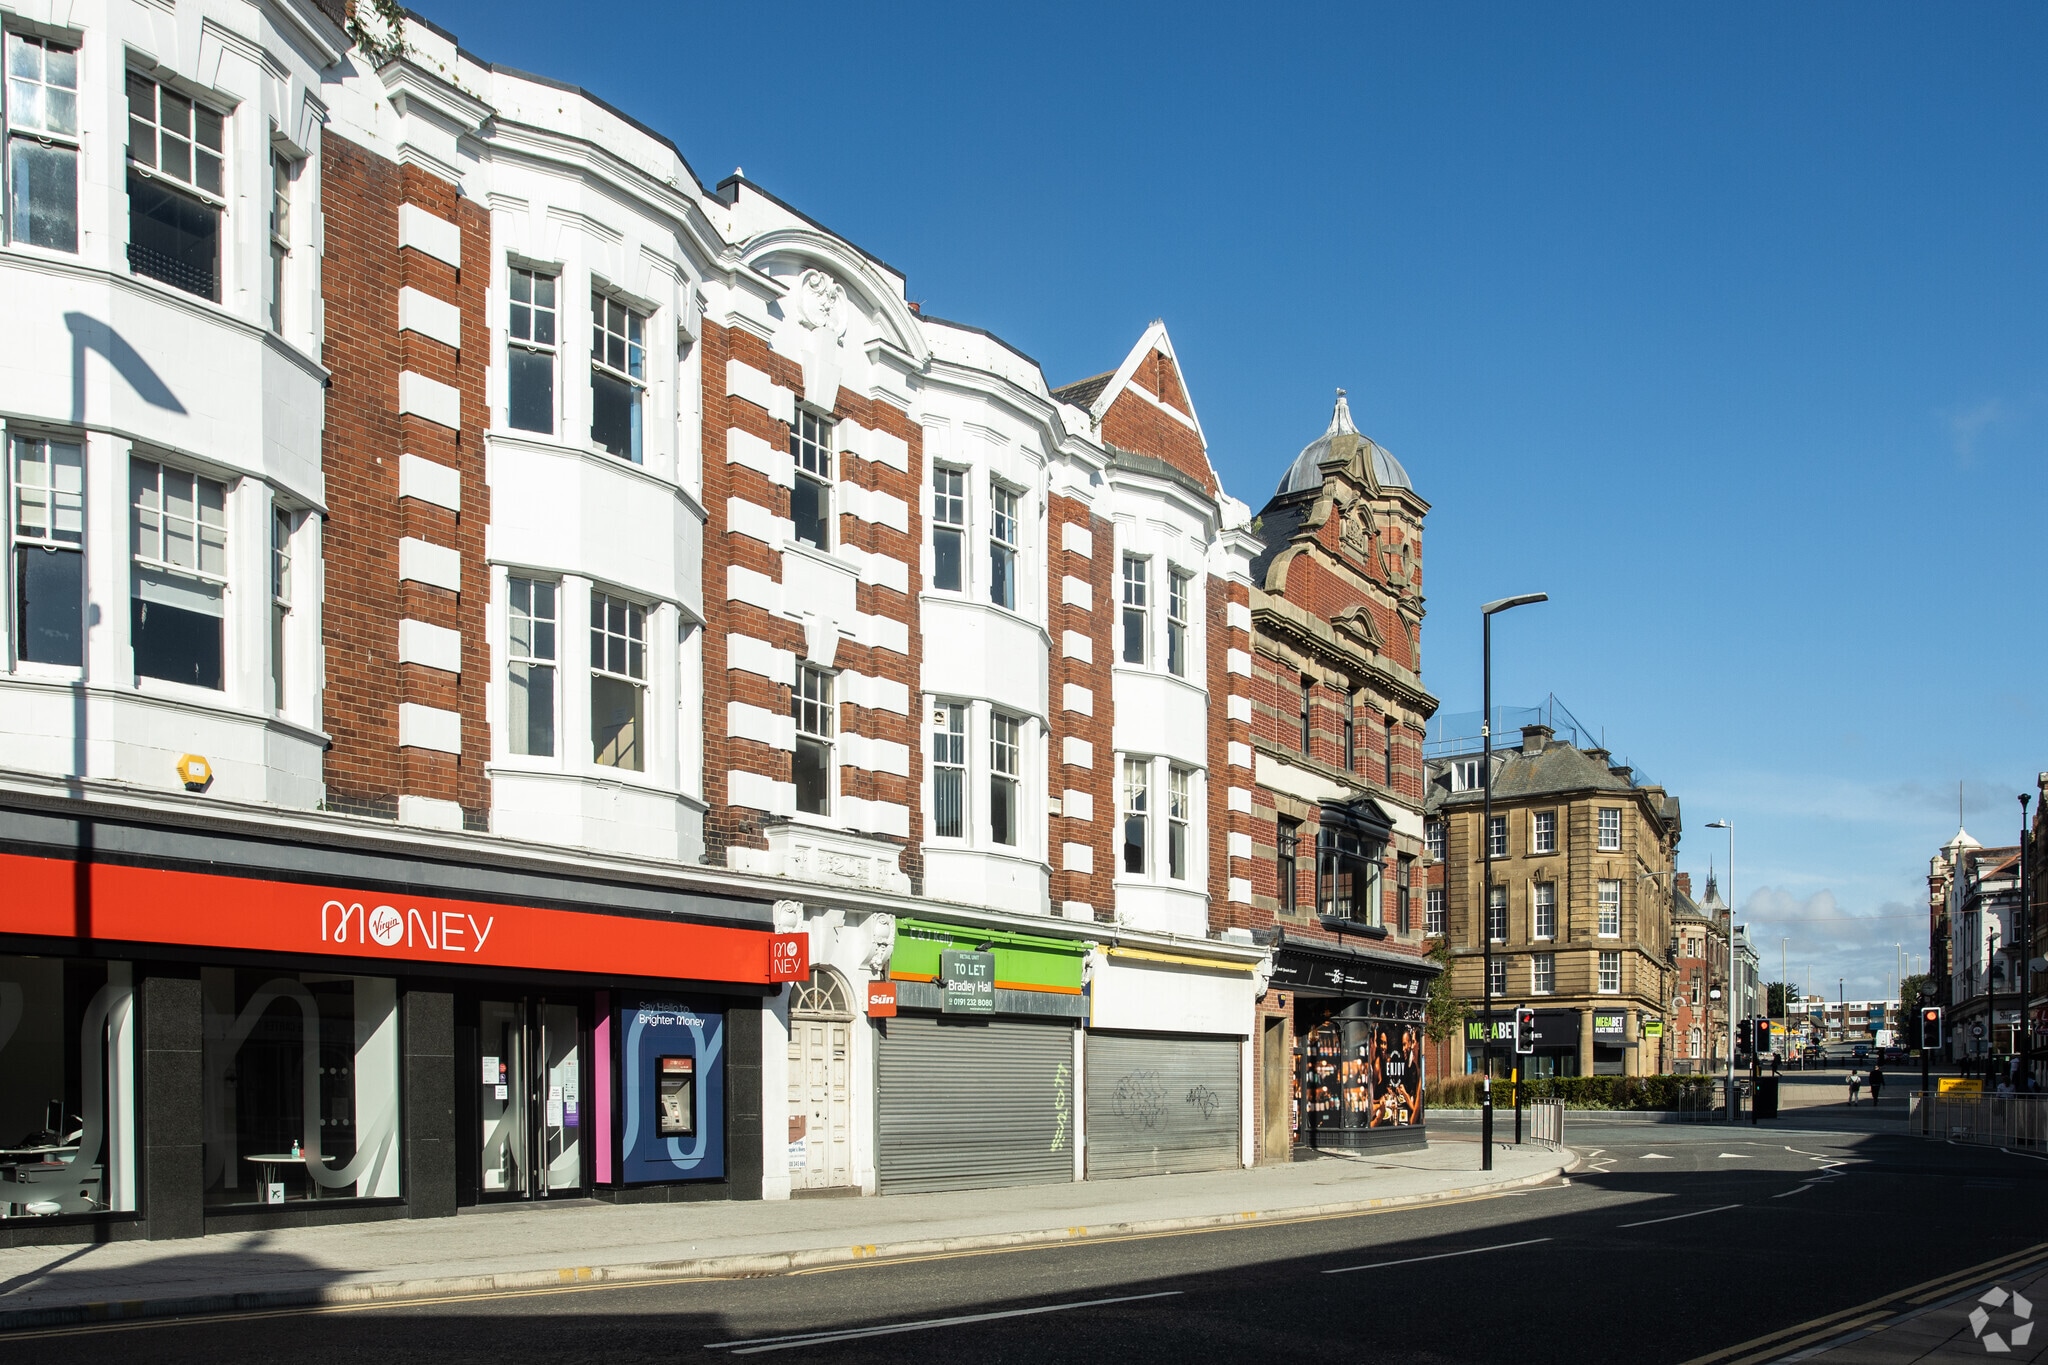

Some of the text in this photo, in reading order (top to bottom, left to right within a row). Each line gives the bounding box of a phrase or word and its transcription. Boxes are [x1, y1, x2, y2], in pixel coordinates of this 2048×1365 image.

[322, 900, 494, 952] MONEY
[373, 911, 400, 939] Virgin
[934, 930, 954, 947] Kelly
[774, 958, 801, 973] NEY
[954, 963, 986, 976] TO LET
[948, 980, 992, 996] Bradley Hall
[639, 1001, 655, 1014] Say
[680, 1004, 690, 1013] to
[953, 998, 993, 1007] 0191 232 8080
[639, 1014, 705, 1028] Brighter Money
[1596, 1017, 1623, 1027] MEGABET
[1469, 1022, 1517, 1040] MEABET
[1386, 1062, 1405, 1076] ENJOY
